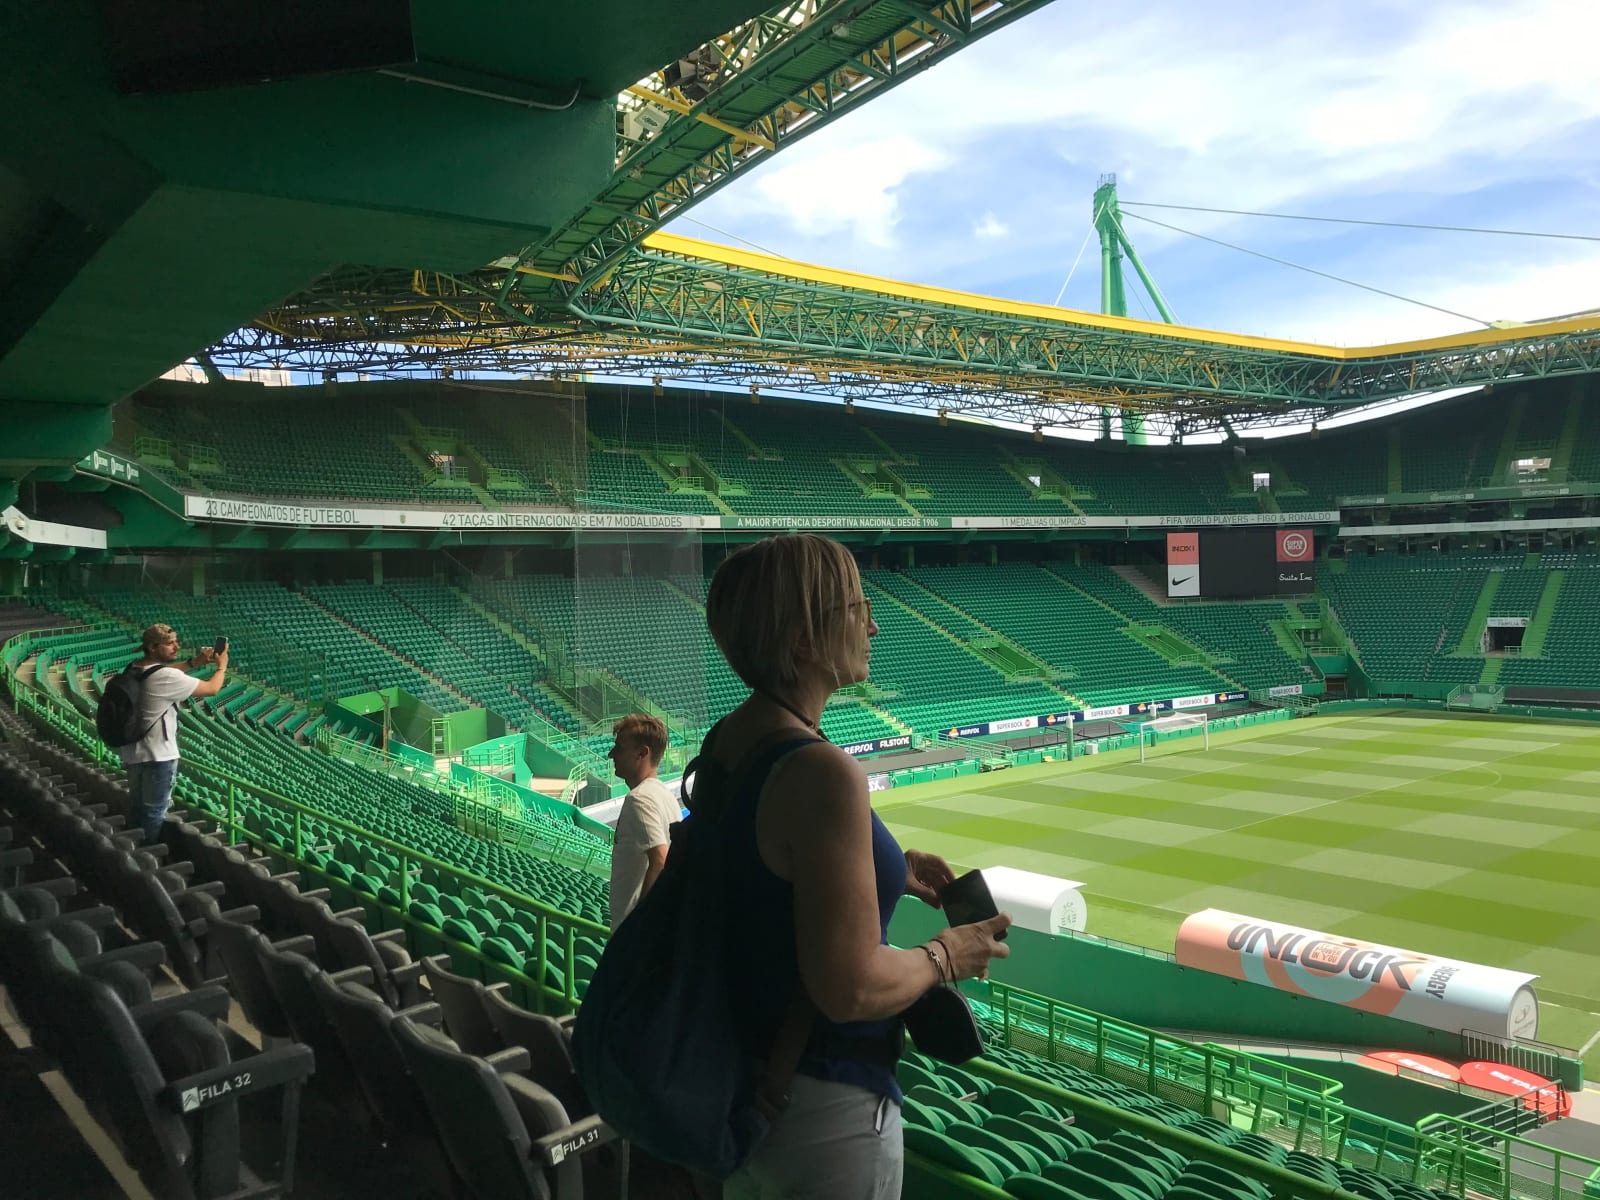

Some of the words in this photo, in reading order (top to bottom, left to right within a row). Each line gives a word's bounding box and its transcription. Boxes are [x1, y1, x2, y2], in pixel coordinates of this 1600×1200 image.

[205, 500, 218, 516] 23
[220, 502, 288, 521] CAMPEONATOS
[290, 507, 301, 522] DE
[303, 508, 360, 524] FUTEBOL
[1160, 516, 1166, 525] 2
[1166, 516, 1183, 525] FIFA
[1185, 515, 1212, 525] WORLD
[1213, 515, 1249, 524] PLAYERS
[1257, 514, 1277, 523] FIGO
[1288, 512, 1332, 521] RONALDO
[442, 513, 456, 526] 42
[458, 513, 495, 528] TAÇAS
[497, 513, 587, 527] INTERNACIONAIS
[589, 515, 604, 527] EM
[606, 515, 613, 527] 7
[614, 515, 683, 528] MODALIDADES
[737, 517, 744, 527] A
[744, 517, 771, 527] MAIOR
[811, 517, 859, 527] DESPORTIVA
[859, 517, 896, 527] NACIONAL
[897, 517, 921, 527] DESDE
[922, 517, 939, 527] 1906
[1010, 517, 1048, 527] MEDALHAS
[844, 742, 874, 755] REPSOL
[879, 736, 910, 749] FILSTONE
[1226, 923, 1427, 992] UNLOCK
[1425, 965, 1461, 1000] ENERGY
[200, 1081, 232, 1101] FILA
[234, 1072, 252, 1088] 32
[563, 1136, 586, 1155] FILA
[587, 1128, 599, 1143] 31
